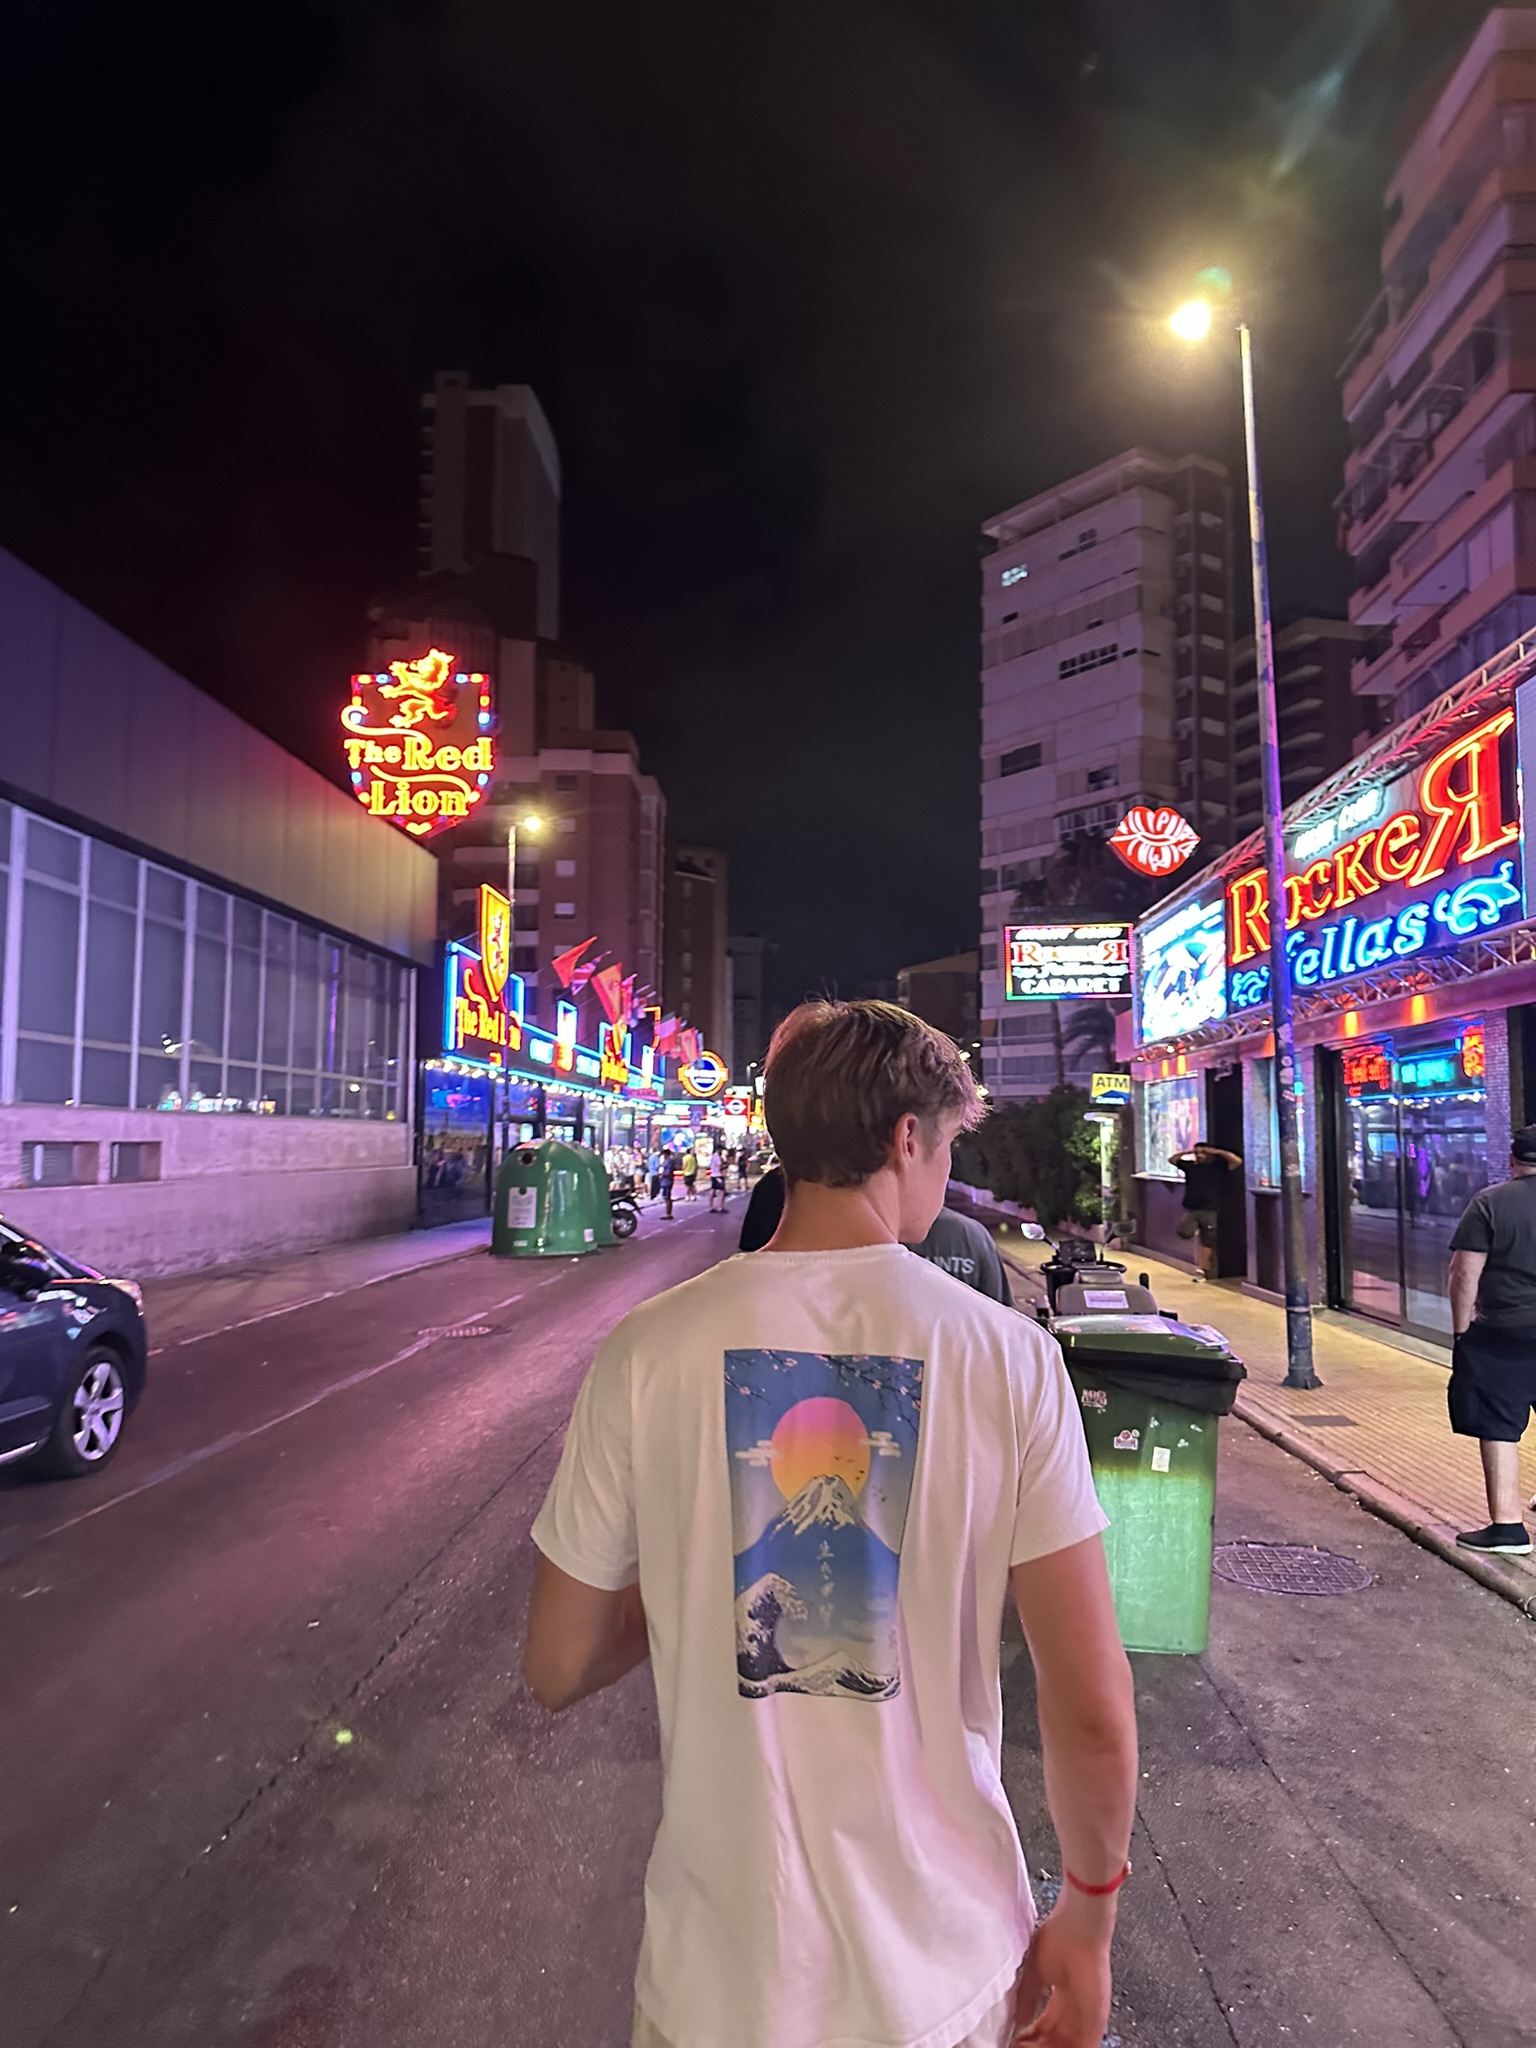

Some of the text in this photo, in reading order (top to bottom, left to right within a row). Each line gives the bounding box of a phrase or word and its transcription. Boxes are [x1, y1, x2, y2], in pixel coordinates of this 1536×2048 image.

[343, 736, 494, 771] The Red
[367, 780, 470, 816] Lion
[1095, 1076, 1129, 1089] ATM
